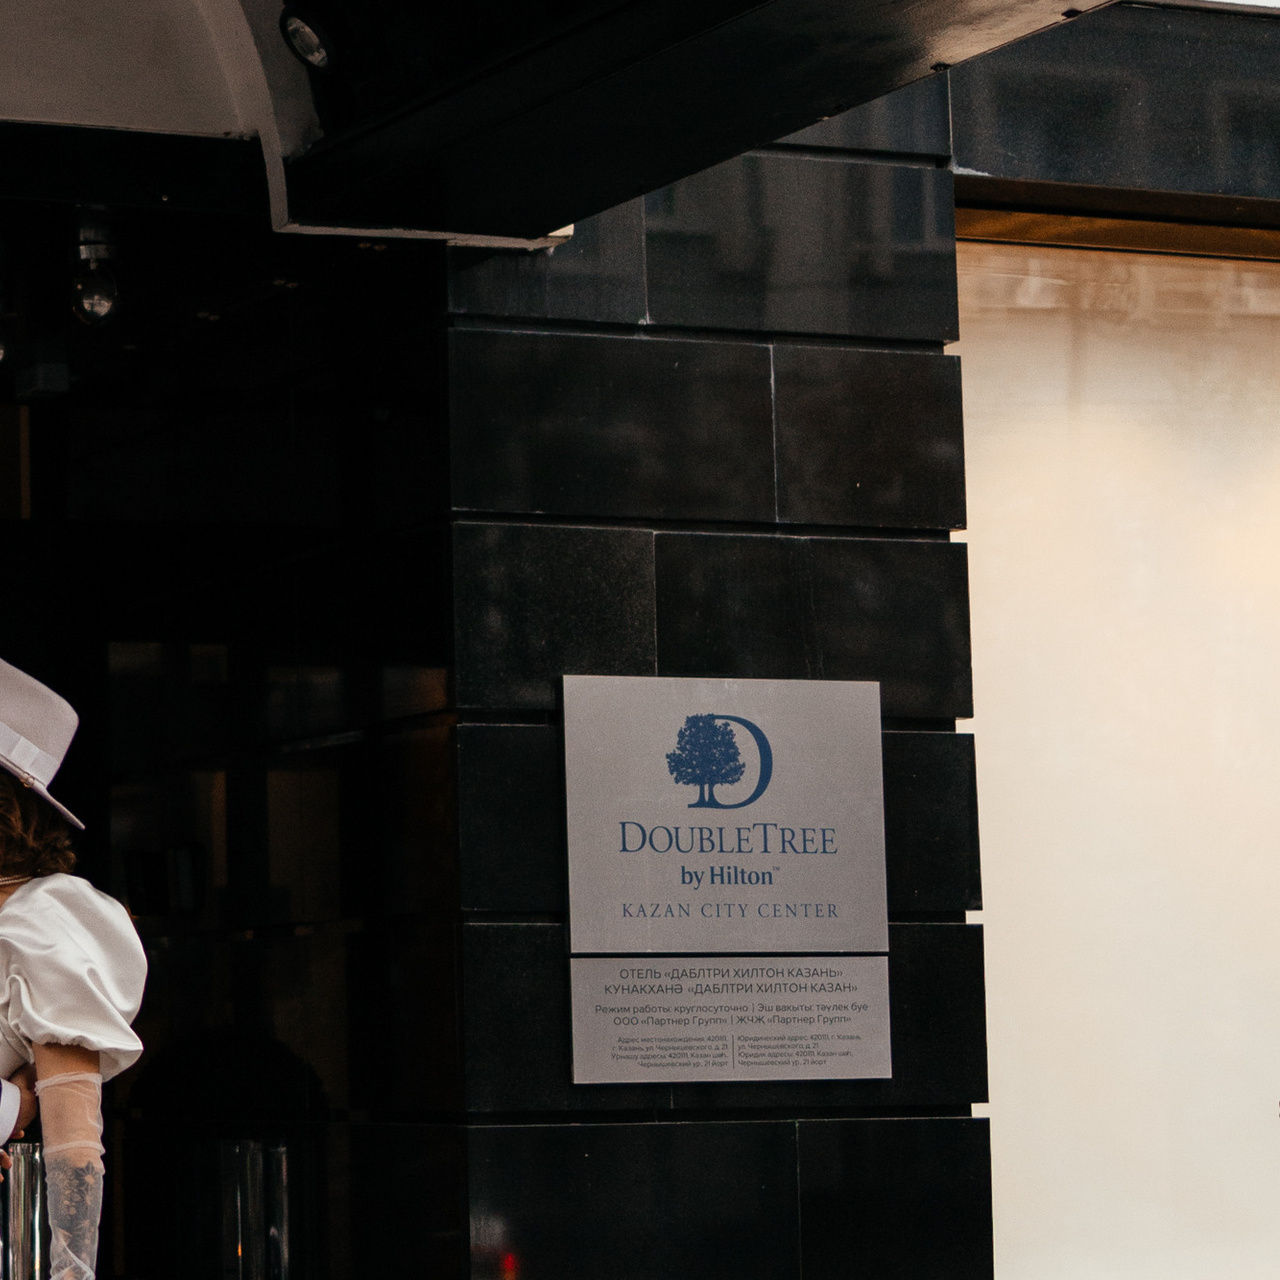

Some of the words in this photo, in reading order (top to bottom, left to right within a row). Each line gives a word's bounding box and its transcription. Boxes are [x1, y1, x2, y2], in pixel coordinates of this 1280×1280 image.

[680, 865, 704, 890] by
[622, 903, 690, 918] KAZAN
[700, 903, 749, 918] CITY
[757, 903, 839, 918] CENTER
[620, 968, 662, 979] ОТЕЛЬ
[664, 968, 730, 980] «ДАБЛТРИ
[733, 967, 784, 978] ХИЛТОН
[787, 967, 843, 978] КАЗАНЬ»
[687, 983, 753, 995] «ДАБЛТРИ
[756, 983, 807, 993] ХИЛТОН
[810, 982, 858, 993] КАЗАН»
[595, 1004, 631, 1014] Режим
[674, 1004, 748, 1015] круглосуточно
[613, 1016, 639, 1026] ООО
[736, 1015, 765, 1024] ЖЧЖ
